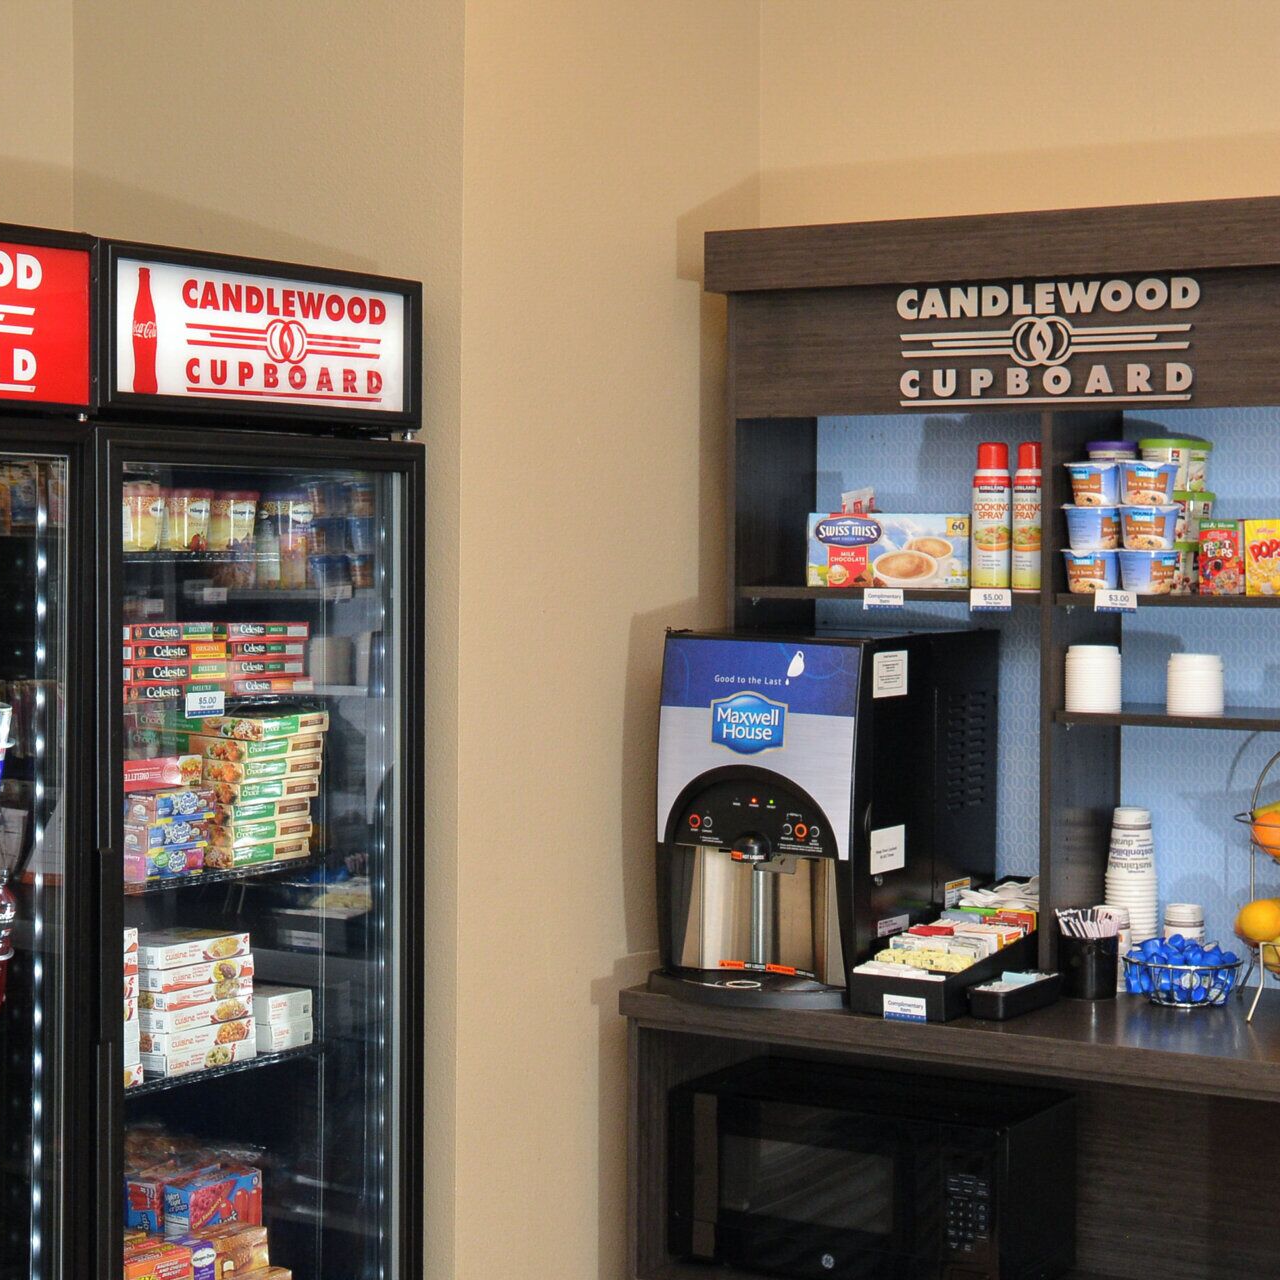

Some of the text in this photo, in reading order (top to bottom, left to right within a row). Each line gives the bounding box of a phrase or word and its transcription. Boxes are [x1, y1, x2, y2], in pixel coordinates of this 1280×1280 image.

[182, 279, 386, 325] CANDLEWOOD
[896, 277, 1200, 320] CANDLEWOOD
[186, 358, 382, 394] CUPBOARD
[900, 362, 1193, 397] CUPBOARD
[975, 503, 1008, 511] COOKING
[978, 511, 1003, 519] SPRAY
[819, 524, 878, 538] SWISS MISS
[952, 521, 965, 531] 60
[1109, 594, 1129, 602] $3.00
[149, 627, 179, 637] Celeste
[240, 625, 264, 634] Celeste
[153, 646, 187, 656] Celeste
[244, 644, 264, 652] Celeste
[153, 667, 186, 677] Celeste
[242, 663, 264, 671] Celeste
[715, 675, 734, 683] Good
[764, 677, 782, 685] Last
[246, 682, 269, 690] Celeste
[147, 687, 181, 697] Celeste
[717, 708, 779, 725] Maxwell
[722, 723, 772, 740] House
